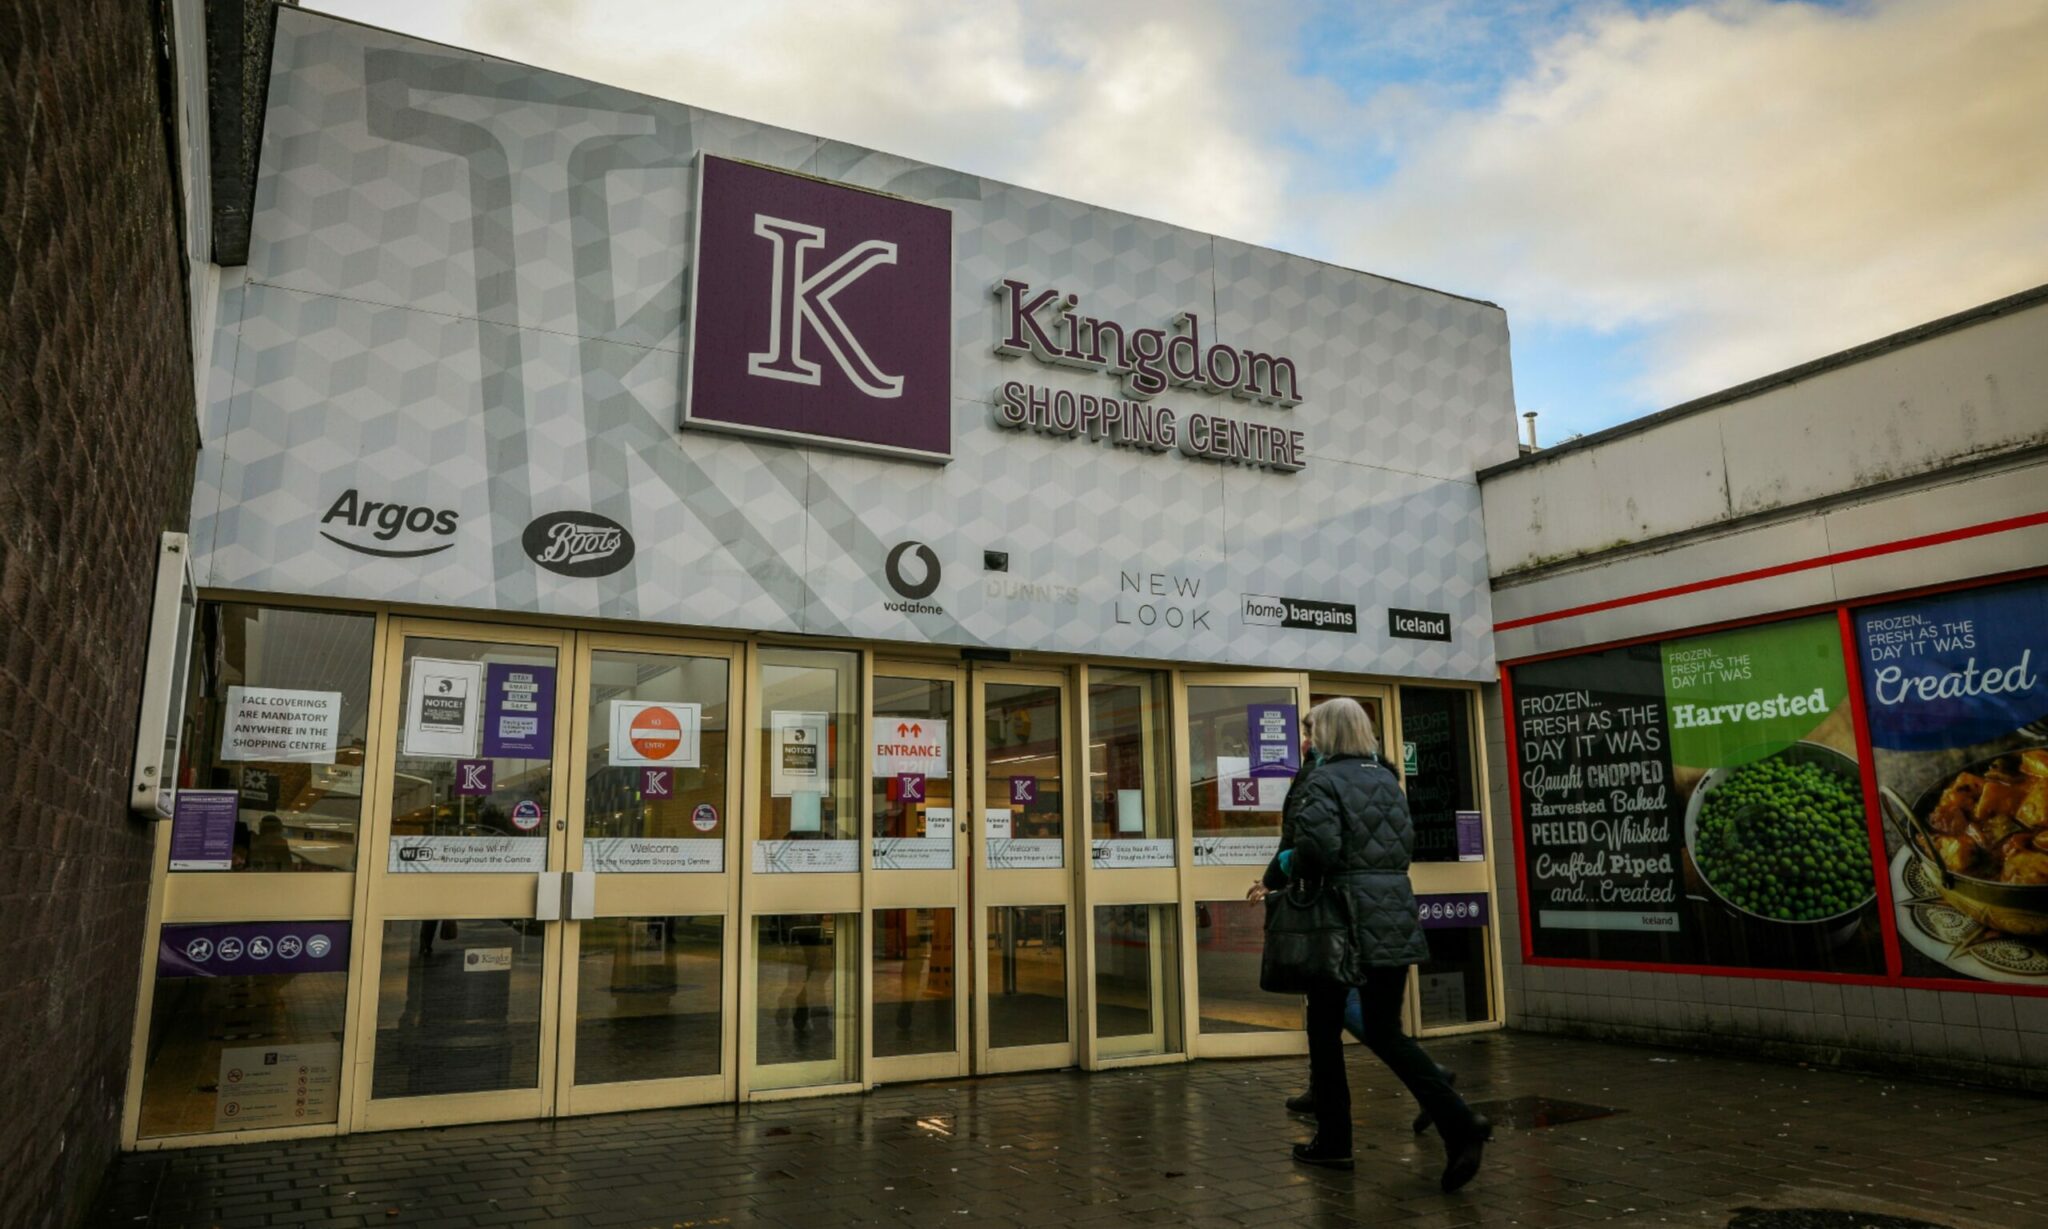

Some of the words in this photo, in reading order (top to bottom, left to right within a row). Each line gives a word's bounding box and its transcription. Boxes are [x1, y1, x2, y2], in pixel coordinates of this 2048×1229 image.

[748, 213, 905, 398] K
[998, 279, 1304, 403] Kingdom
[999, 380, 1177, 450] SHOPPING
[1187, 412, 1306, 470] CENTRE
[320, 488, 460, 541] Argos
[536, 521, 622, 564] Boots
[1120, 570, 1201, 599] NEW
[883, 601, 943, 616] vodafone
[1115, 602, 1211, 631] LOOK
[1245, 601, 1283, 619] home
[1290, 603, 1353, 626] bargains
[1395, 615, 1445, 635] Iceland
[1866, 614, 1931, 633] FROZEN...
[1868, 630, 1914, 646] FRESH
[1919, 626, 1938, 640] AS
[1943, 620, 1974, 635] THE
[1669, 648, 1718, 663] FROZEN...
[1871, 645, 1903, 661] DAY
[1911, 641, 1926, 656] IT
[1934, 634, 1976, 653] WAS
[1671, 661, 1705, 676] FRESH
[1709, 659, 1724, 671] AS
[1727, 655, 1750, 668] THE
[1875, 649, 2037, 705] Created
[1672, 674, 1697, 689] DAY
[1702, 671, 1715, 685] IT
[1719, 666, 1752, 683] WAS
[242, 695, 267, 707] FACE
[269, 697, 328, 709] COVERINGS
[425, 699, 463, 709] NOTICE!
[1521, 690, 1602, 716] FROZEN...
[1673, 688, 1829, 729] Harvested
[238, 710, 258, 721] ARE
[261, 711, 328, 723] MANDATORY
[1523, 714, 1579, 738] FRESH
[1587, 710, 1611, 730] AS
[1618, 704, 1659, 726] THE
[234, 725, 293, 736] ANYWHERE
[295, 726, 306, 737] IN
[308, 726, 328, 737] THE
[232, 738, 286, 750] SHOPPING
[289, 740, 327, 751] CENTRE
[877, 743, 941, 757] ENTRANCE
[1525, 738, 1566, 763] DAY
[1576, 735, 1594, 758] IT
[1605, 728, 1661, 754] WAS
[463, 763, 486, 789] K
[646, 771, 668, 794] K
[1523, 764, 1583, 801] Caught
[1588, 760, 1663, 787] CHOPPED
[902, 777, 921, 799] K
[1014, 780, 1032, 801] K
[1237, 781, 1255, 801] K
[1531, 795, 1605, 816] Harvested
[1610, 787, 1667, 813] Baked
[1532, 821, 1588, 846] PEELED
[1591, 815, 1669, 851] Whisked
[443, 845, 466, 853] Enjoy
[468, 845, 484, 853] free
[630, 843, 679, 853] Welcome
[442, 856, 488, 864] throughout
[619, 858, 651, 866] Kingdom
[652, 858, 685, 867] Shopping
[1536, 851, 1606, 883] Crafted
[1609, 854, 1673, 878] Piped
[1641, 916, 1673, 926] Iceland
